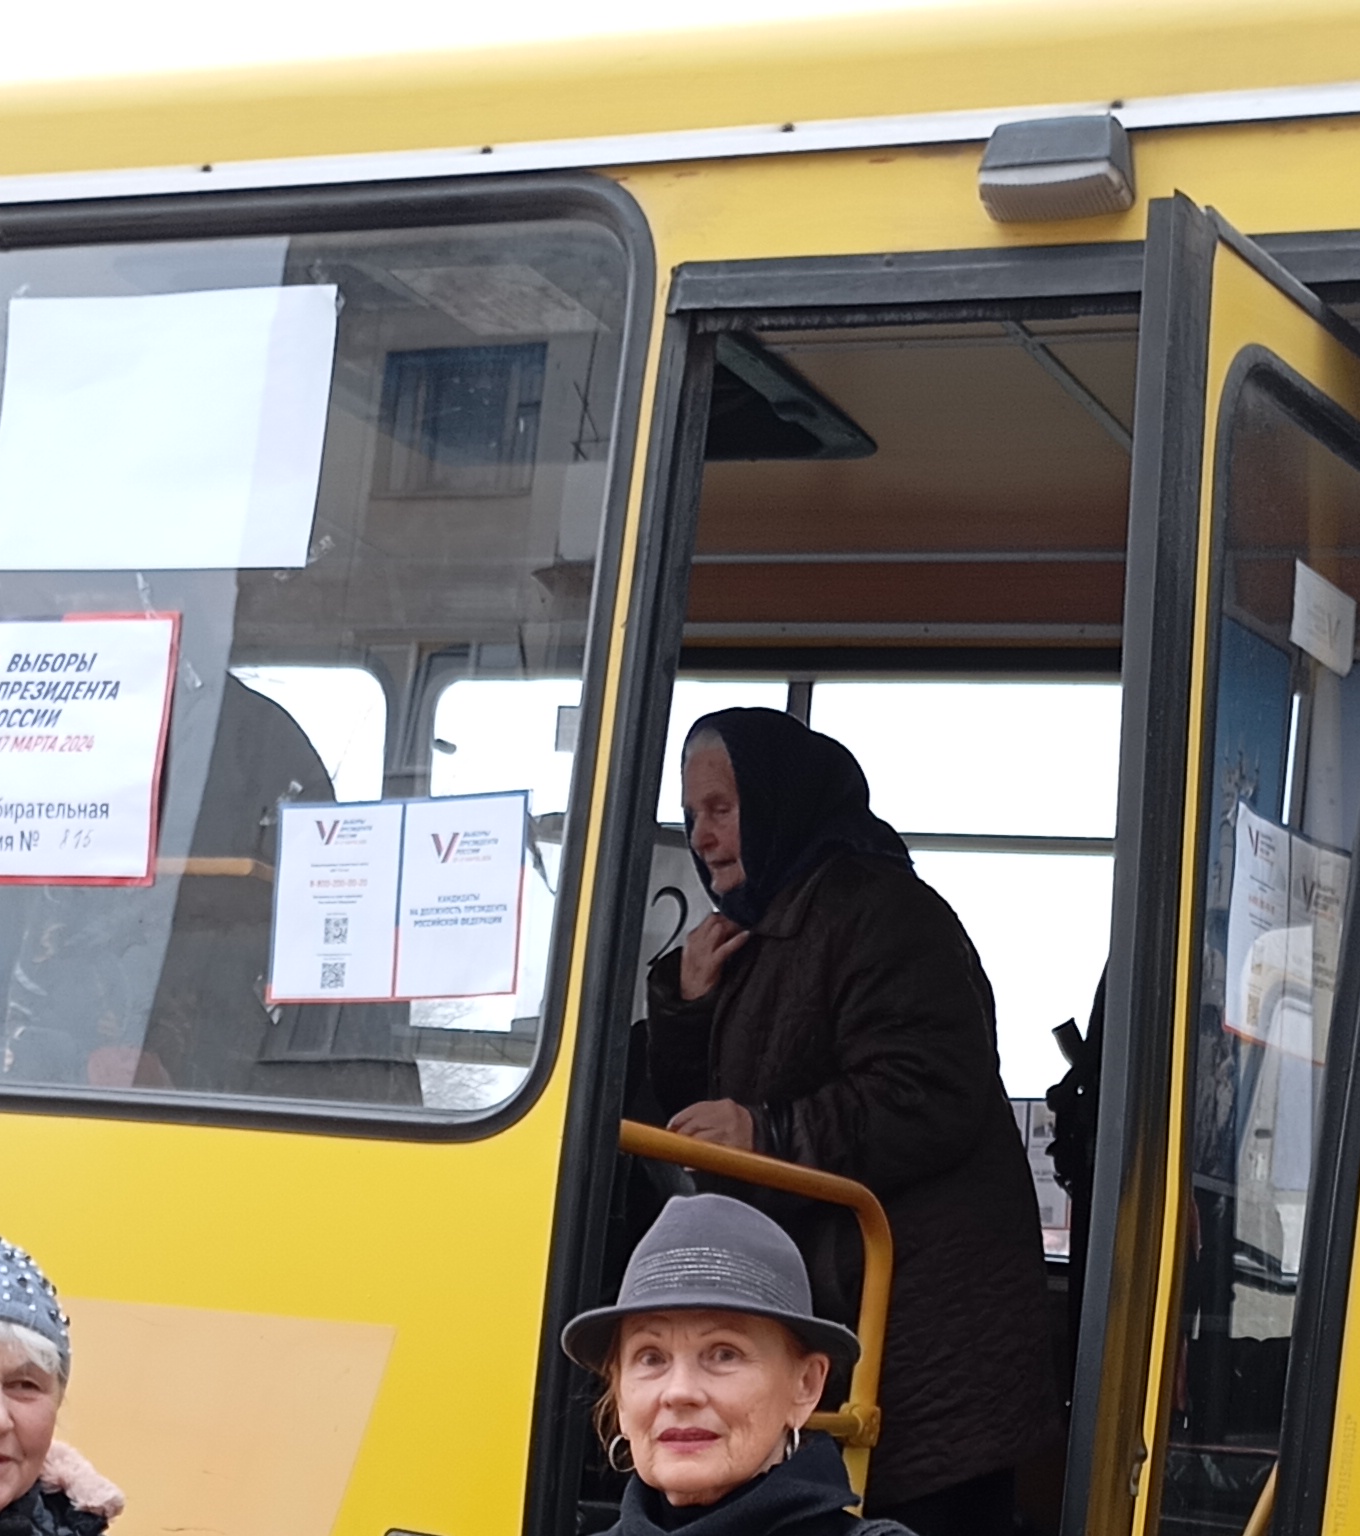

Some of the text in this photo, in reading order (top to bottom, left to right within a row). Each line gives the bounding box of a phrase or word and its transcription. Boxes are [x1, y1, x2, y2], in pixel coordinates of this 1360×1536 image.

[6, 652, 98, 673] ВЫБОРЫ
[9, 735, 59, 753] МАРТА
[58, 735, 95, 753] 2024
[19, 830, 41, 852] №
